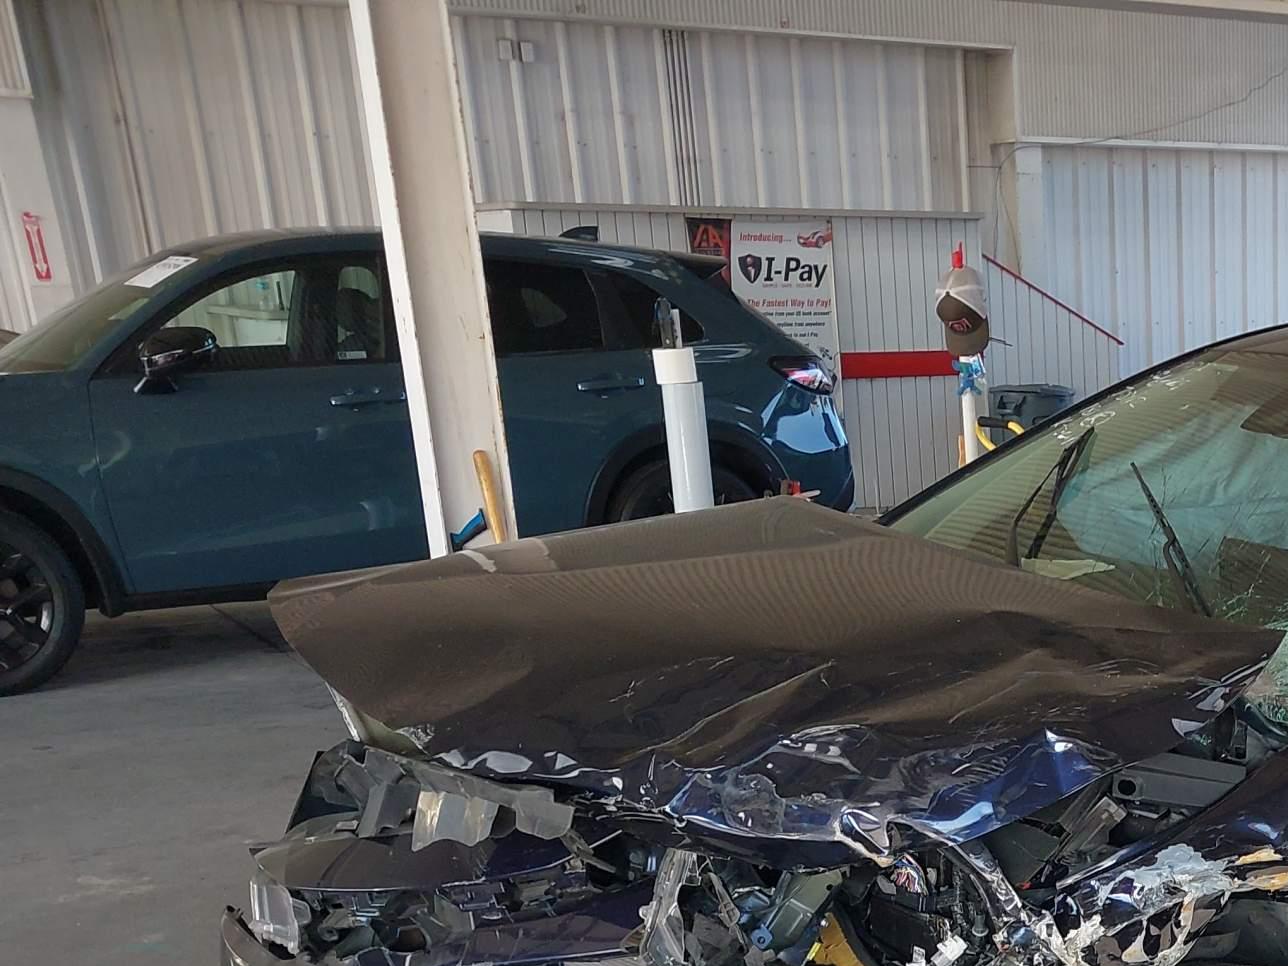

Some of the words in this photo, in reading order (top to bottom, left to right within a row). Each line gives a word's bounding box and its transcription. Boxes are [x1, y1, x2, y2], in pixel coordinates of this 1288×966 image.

[764, 256, 828, 288] I-Pay
[762, 299, 788, 308] Fastest
[790, 299, 805, 309] Way
[806, 299, 814, 308] to
[815, 299, 831, 309] Pay!
